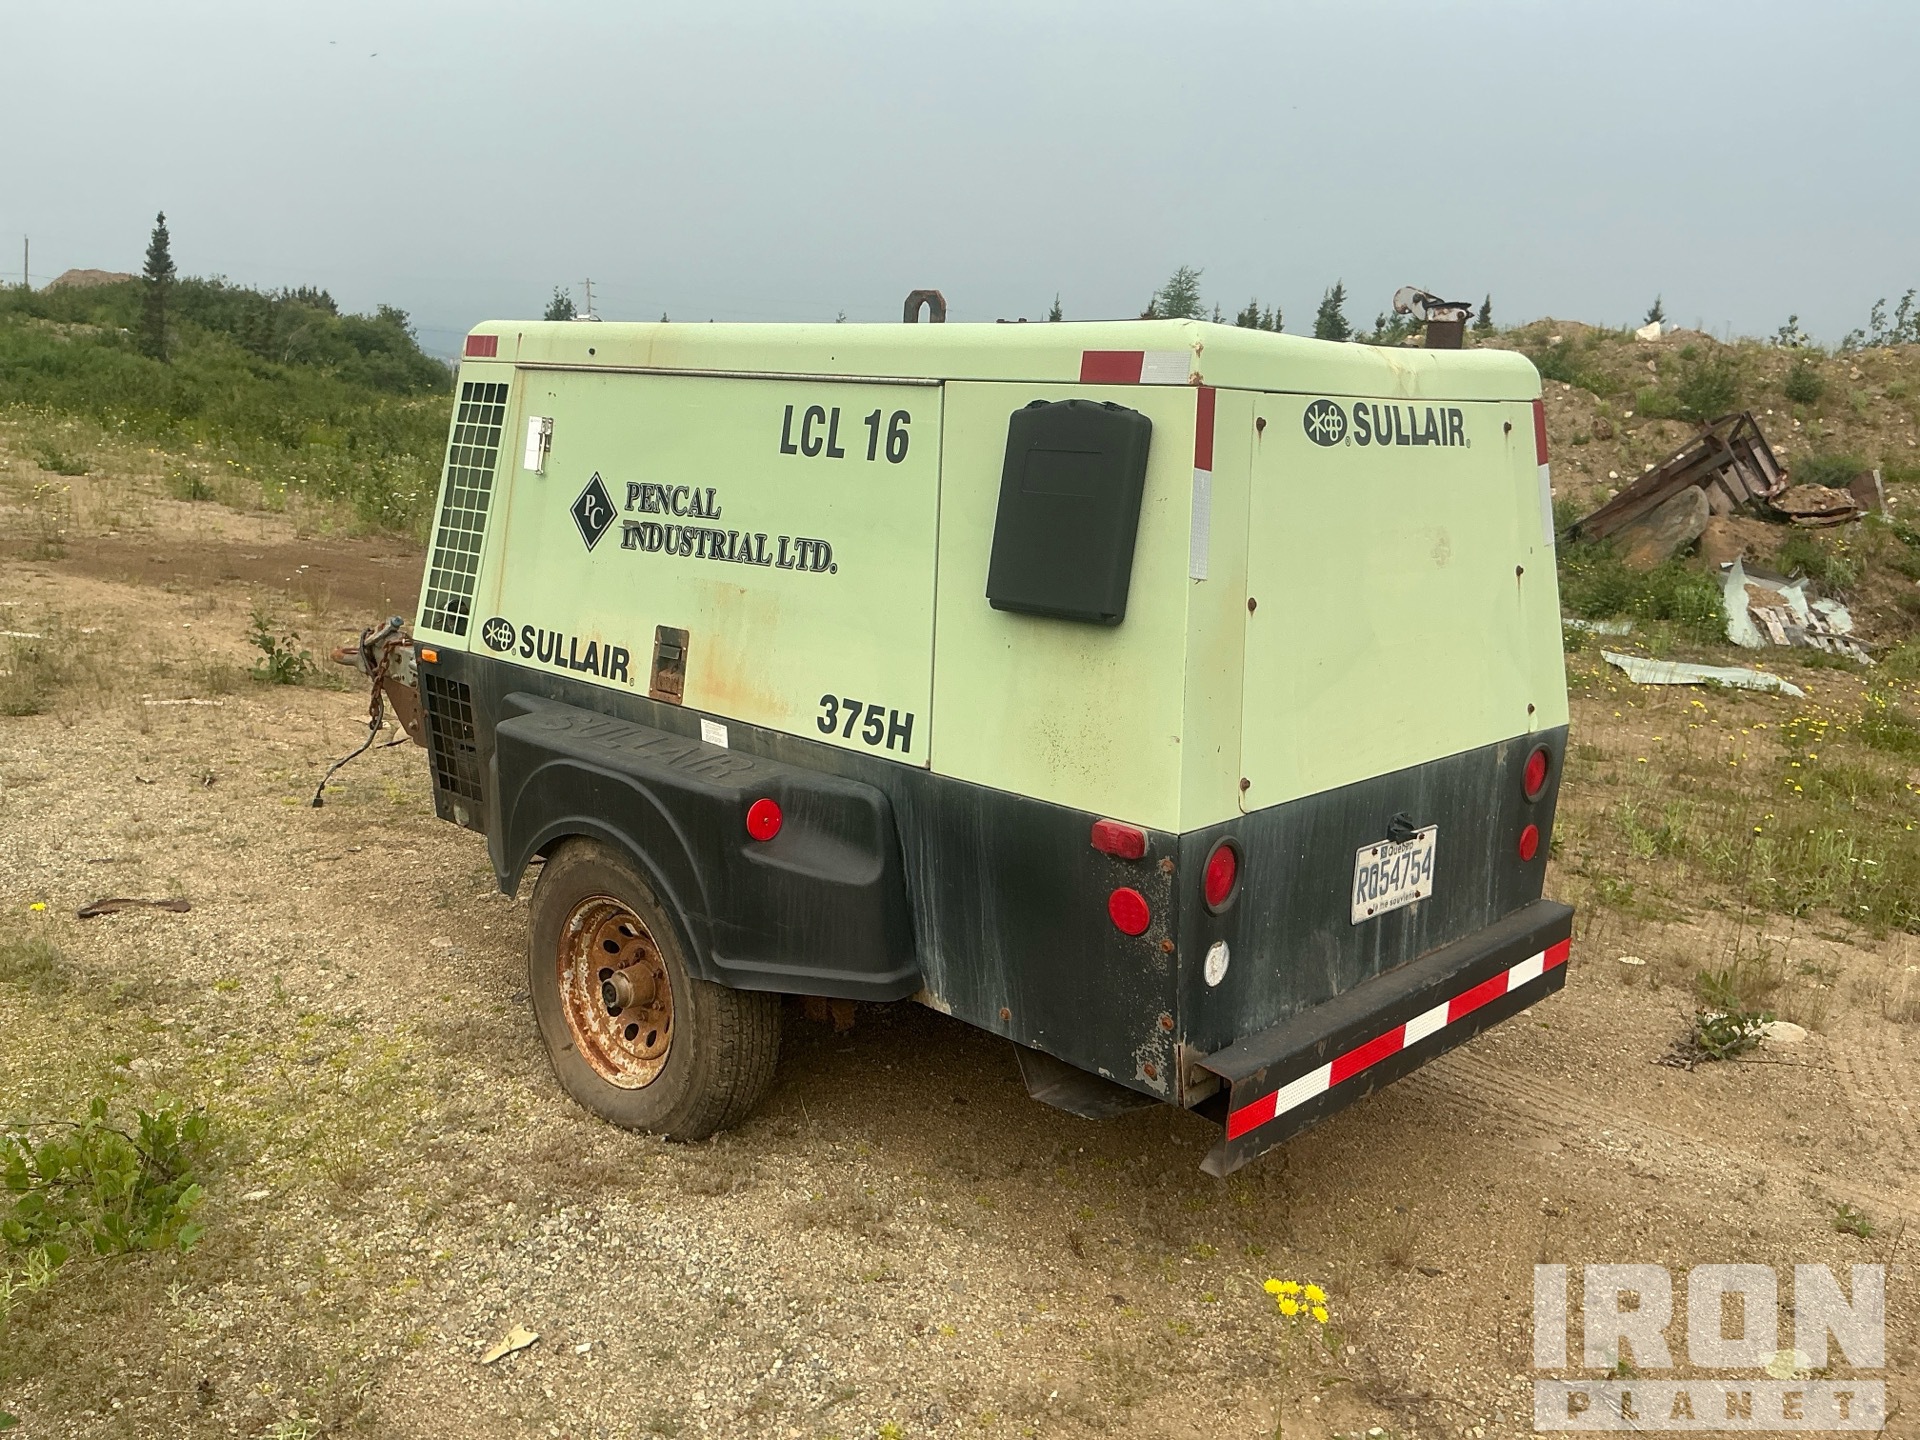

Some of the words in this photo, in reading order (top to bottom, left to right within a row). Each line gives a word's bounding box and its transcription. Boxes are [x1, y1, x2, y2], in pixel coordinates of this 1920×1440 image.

[780, 405, 845, 458] LCL
[865, 410, 911, 464] 16
[1354, 402, 1464, 446] SULLAIR
[624, 482, 722, 520] PENCAL
[621, 520, 772, 566] INDUSTRIAL
[775, 535, 838, 575] LTD.
[519, 625, 630, 682] SULLAIR
[538, 713, 755, 779] SULLAIR
[816, 694, 914, 753] 375H
